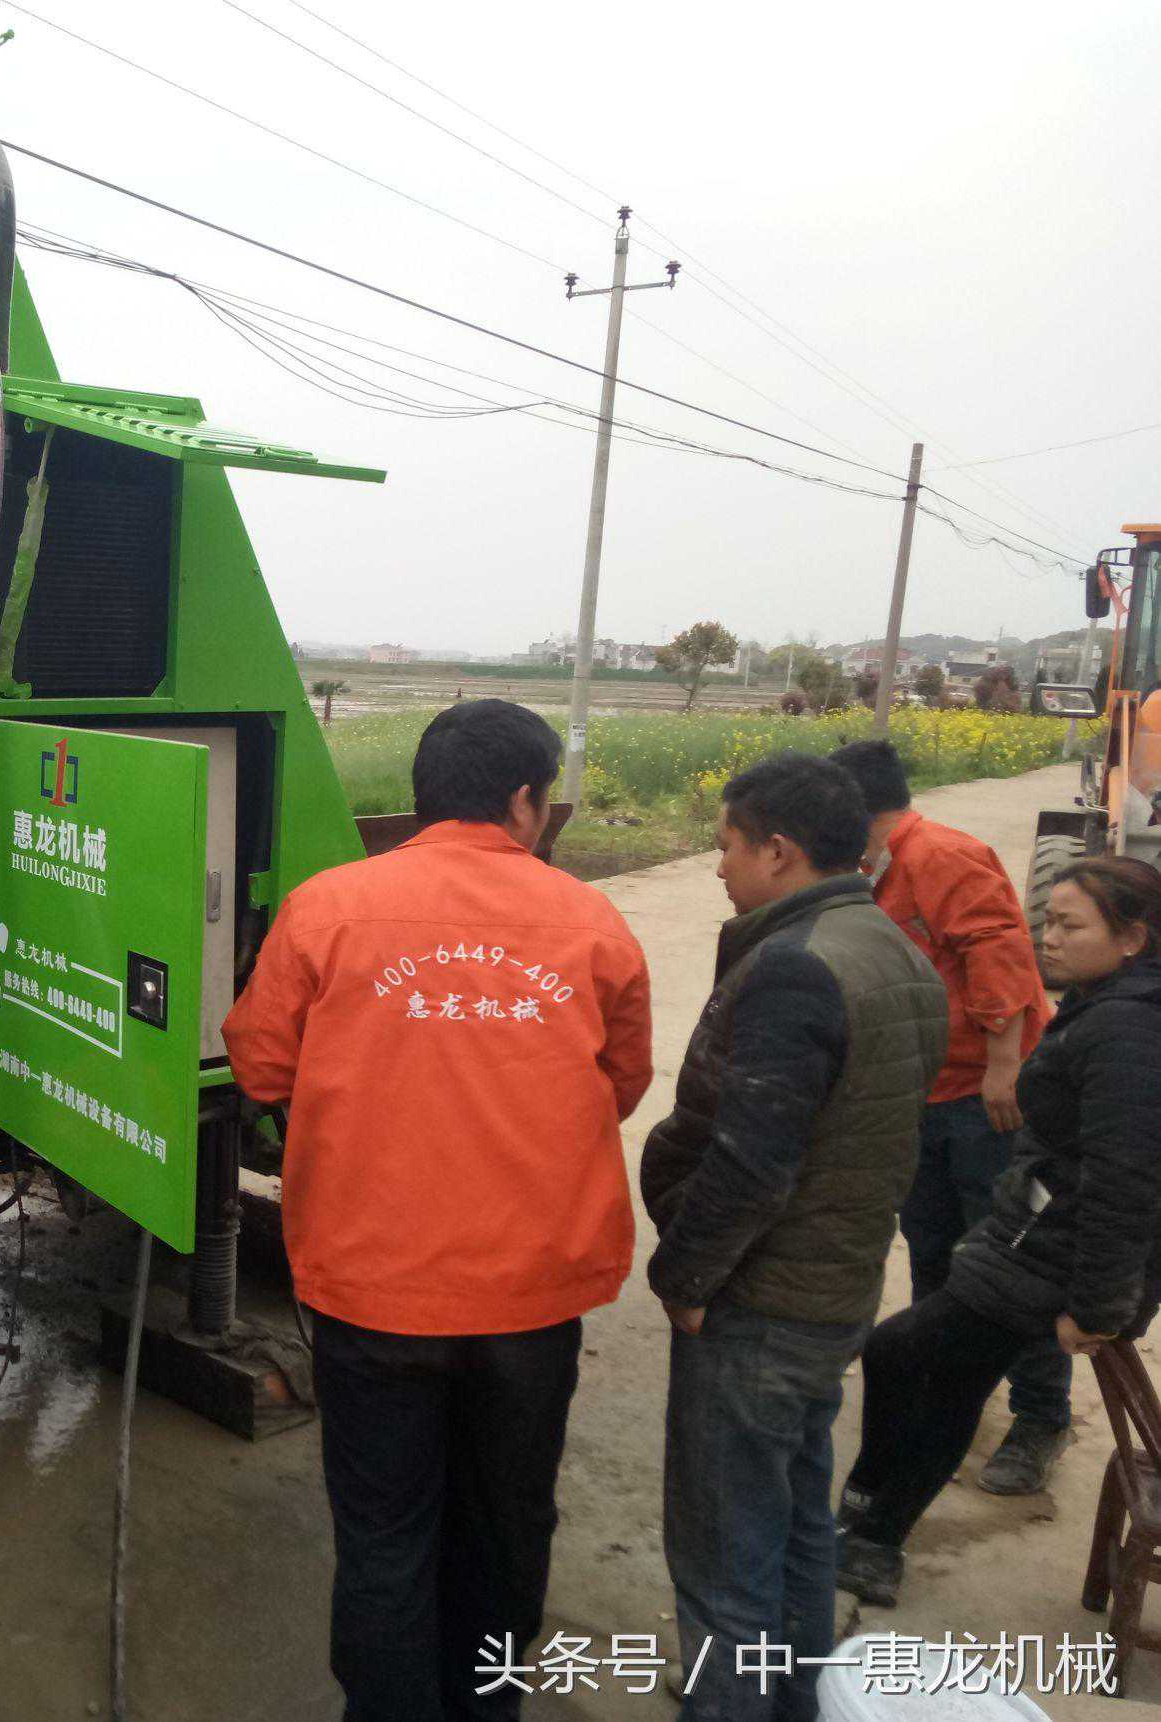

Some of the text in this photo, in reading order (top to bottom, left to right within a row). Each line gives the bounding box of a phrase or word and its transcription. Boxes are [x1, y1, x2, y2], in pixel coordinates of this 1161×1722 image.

[12, 810, 107, 872] 惠龙机械
[11, 852, 107, 897] HUILONGJIXIE
[15, 938, 68, 973] 惠龙机械
[373, 942, 574, 1004] 400-6449-400
[406, 990, 545, 1025] 惠龙机械
[0, 1049, 167, 1164] 湖南中一惠龙机械设备有限公司
